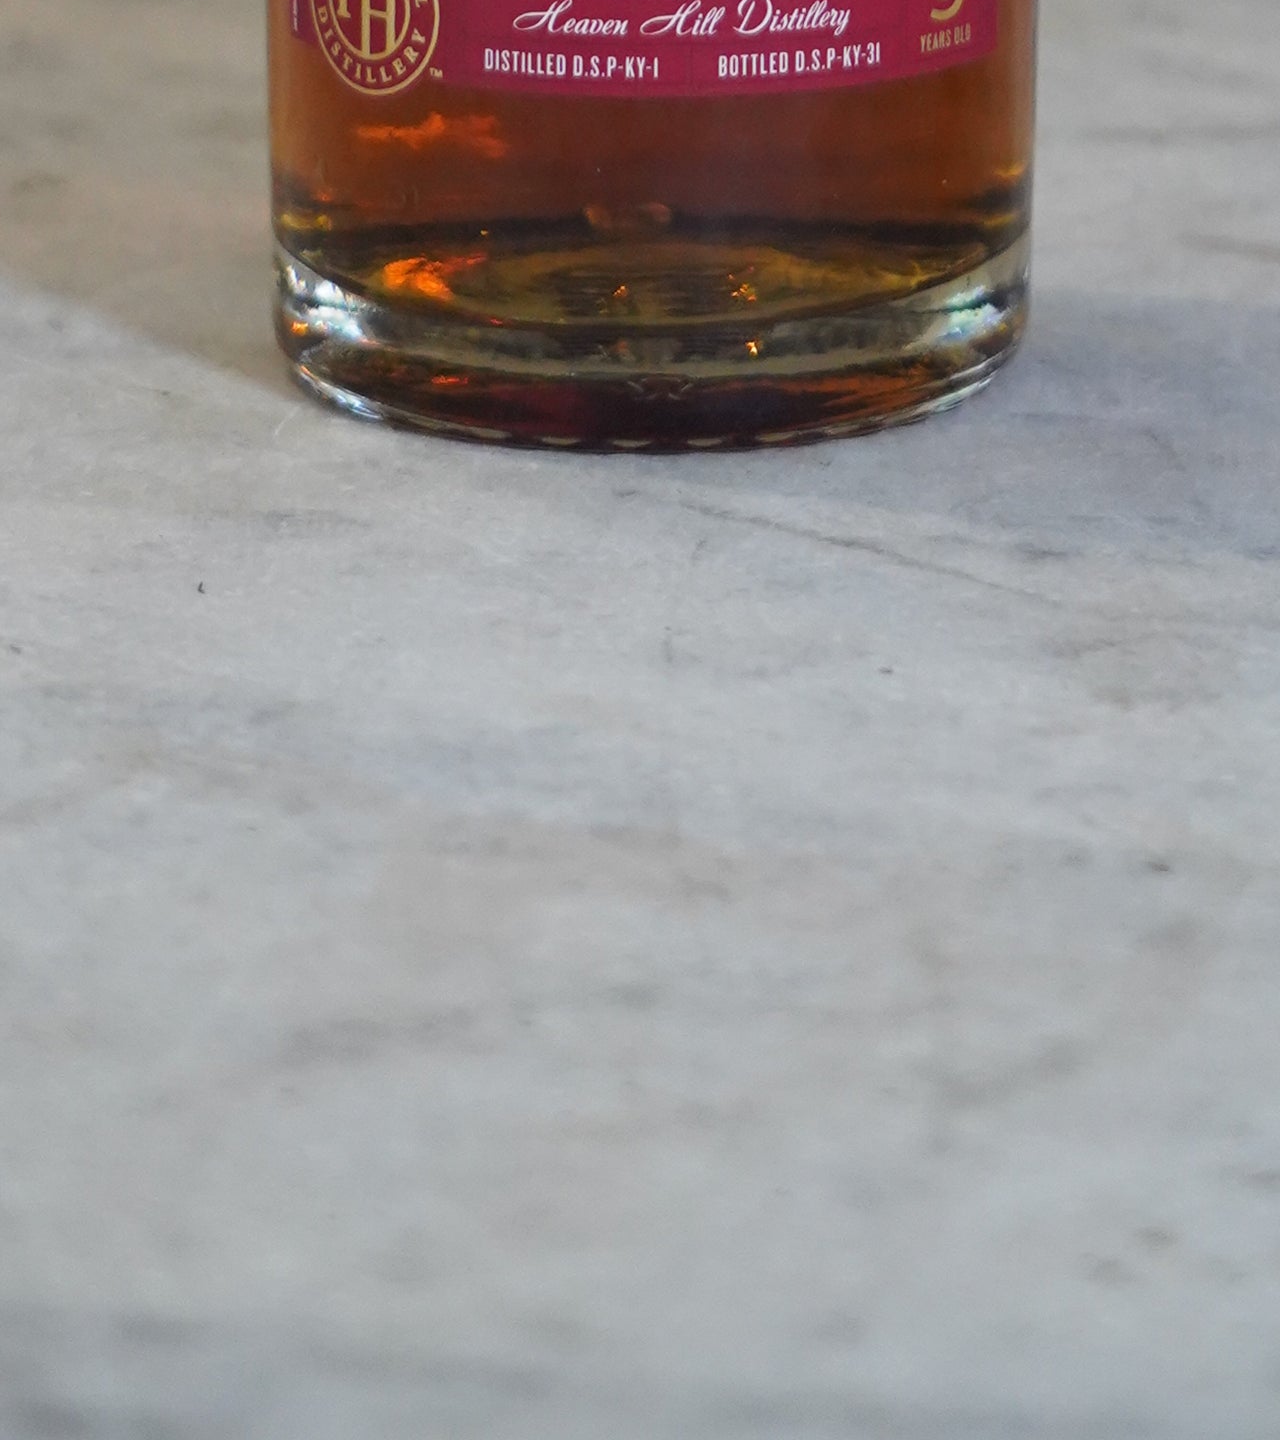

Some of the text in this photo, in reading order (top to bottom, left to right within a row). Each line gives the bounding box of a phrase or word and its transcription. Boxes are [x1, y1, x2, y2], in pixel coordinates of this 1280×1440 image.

[639, 0, 727, 37] Hill
[317, 4, 426, 84] DISTILLERY
[920, 29, 951, 53] YEARS
[484, 47, 567, 76] DISTILLED
[718, 51, 789, 77] BOTTLED
